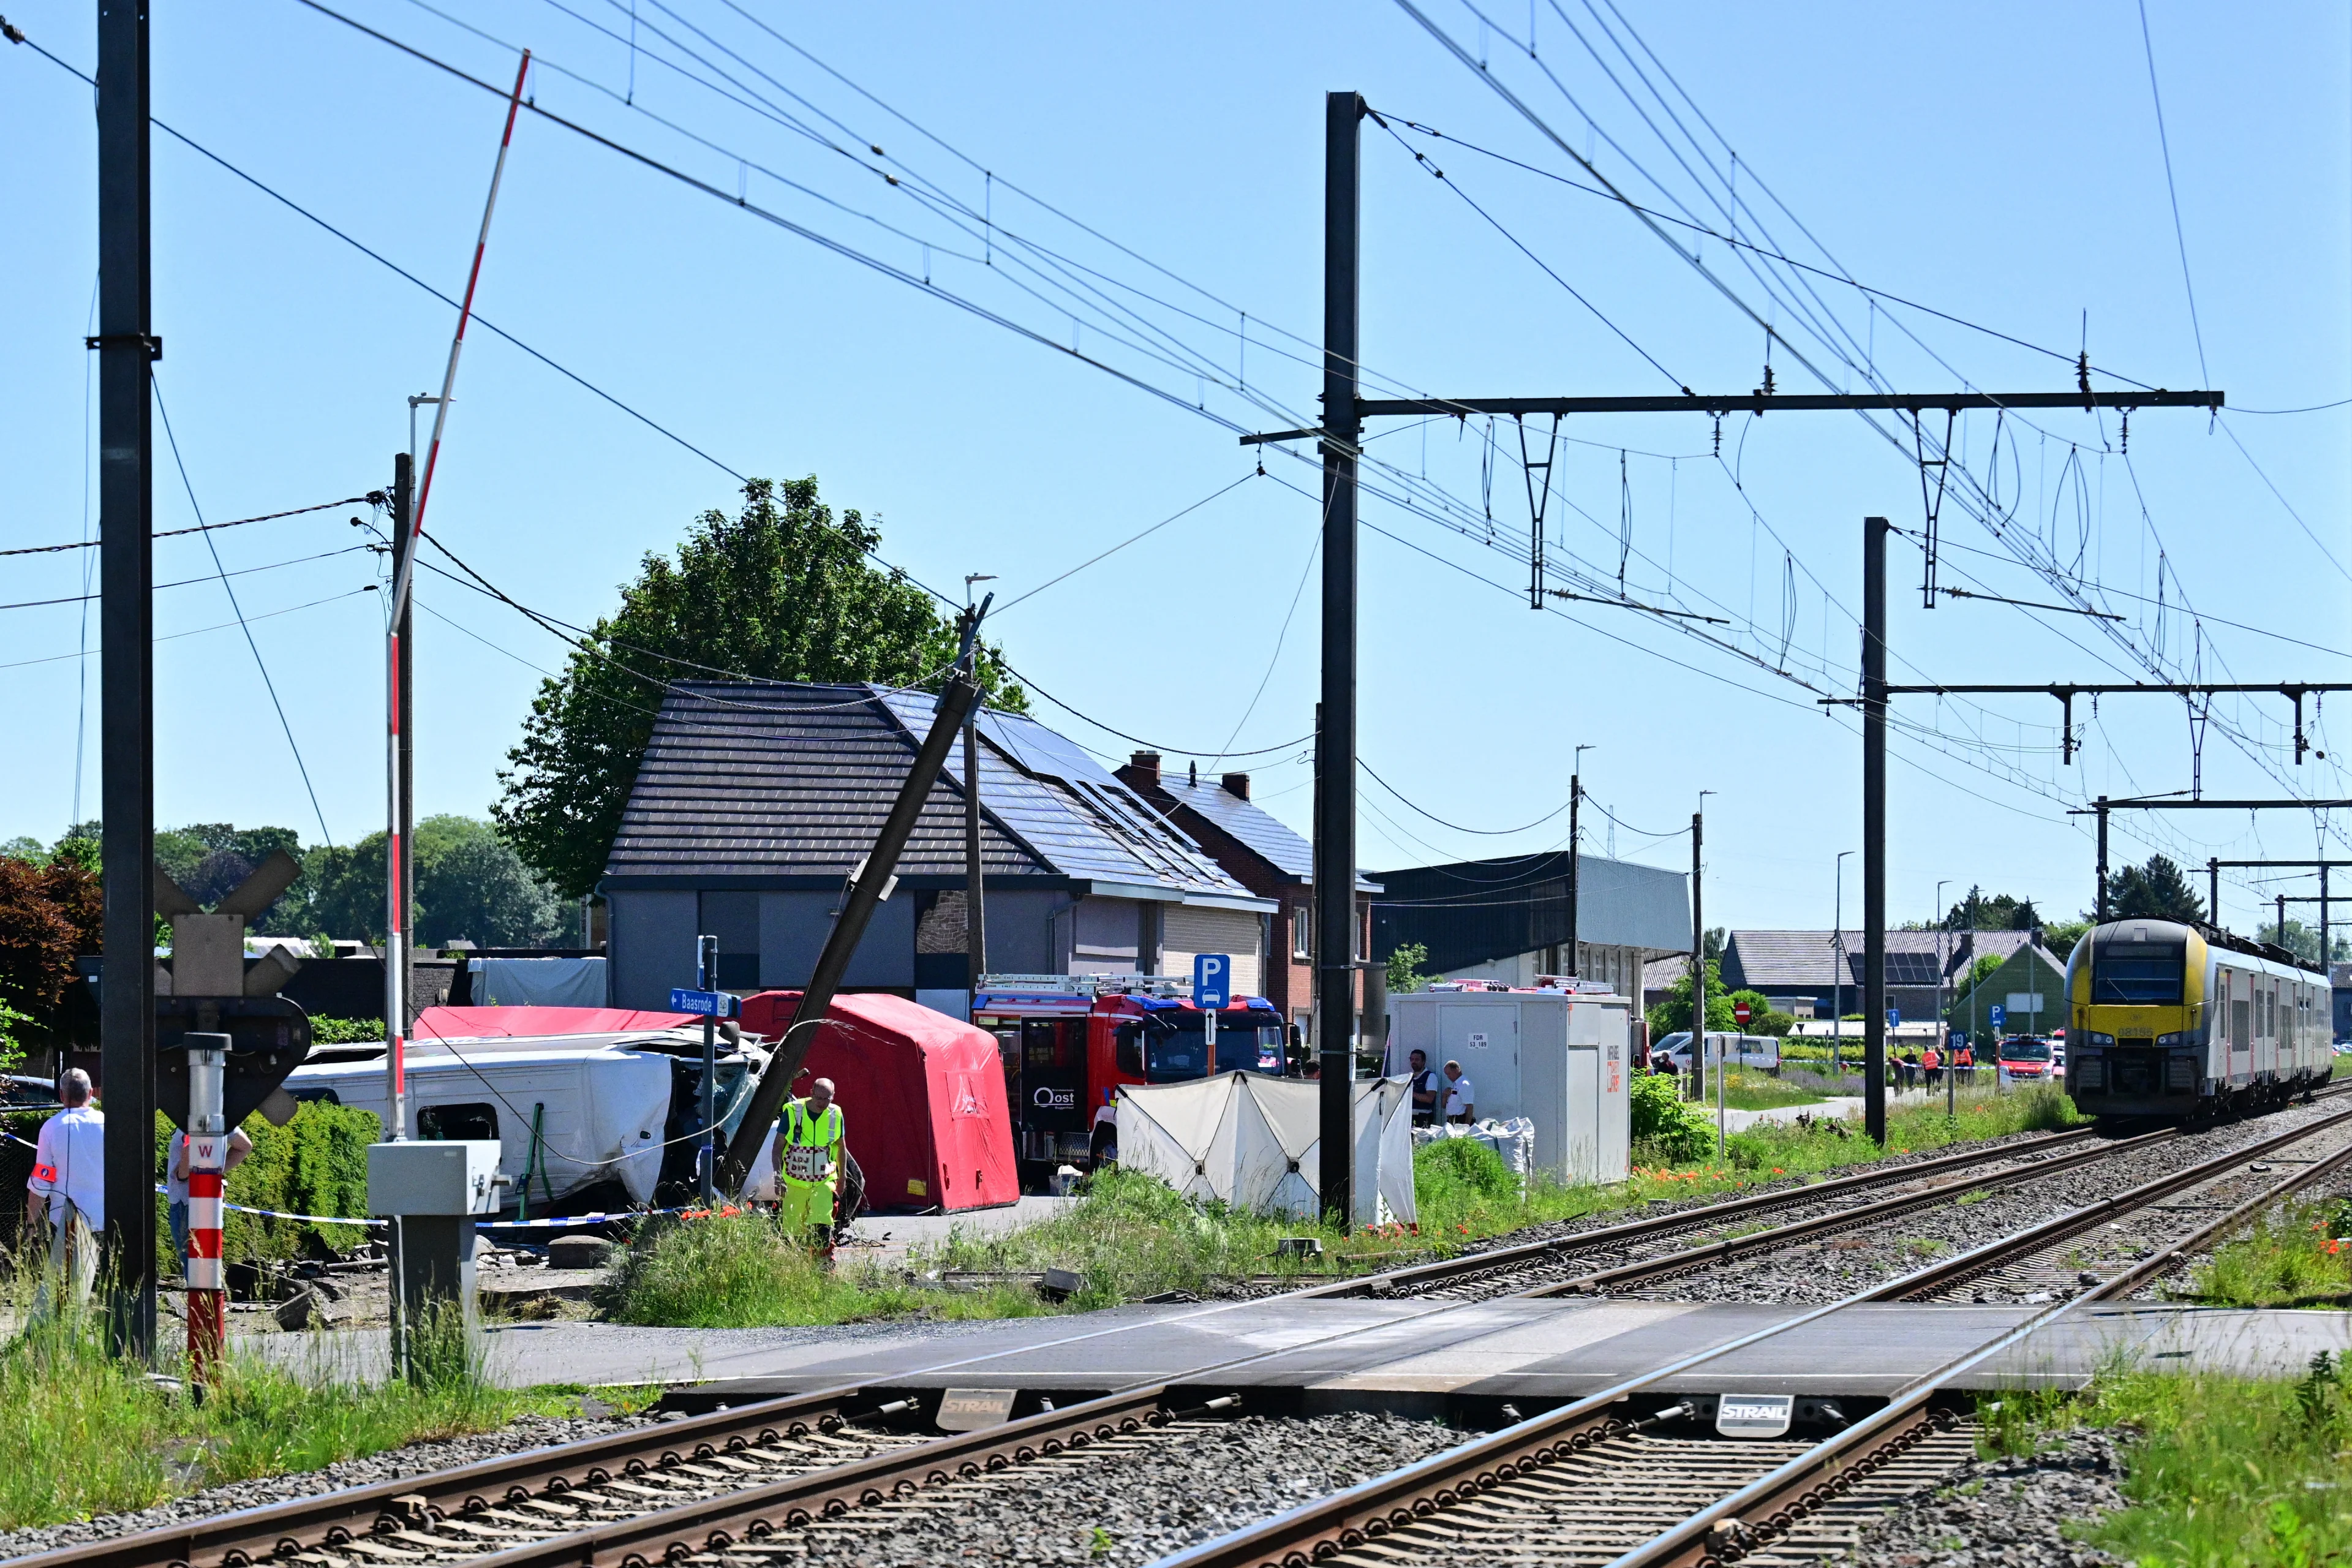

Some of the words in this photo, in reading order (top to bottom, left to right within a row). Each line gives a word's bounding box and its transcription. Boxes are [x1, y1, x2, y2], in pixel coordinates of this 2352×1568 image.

[1202, 958, 1221, 986] P
[682, 993, 712, 1012] Baasrode
[1992, 1006, 2000, 1017] P
[1951, 1034, 1964, 1047] 19
[198, 1145, 213, 1158] W
[944, 1400, 1007, 1412] STRAIL
[1722, 1406, 1788, 1419] STRAIL
